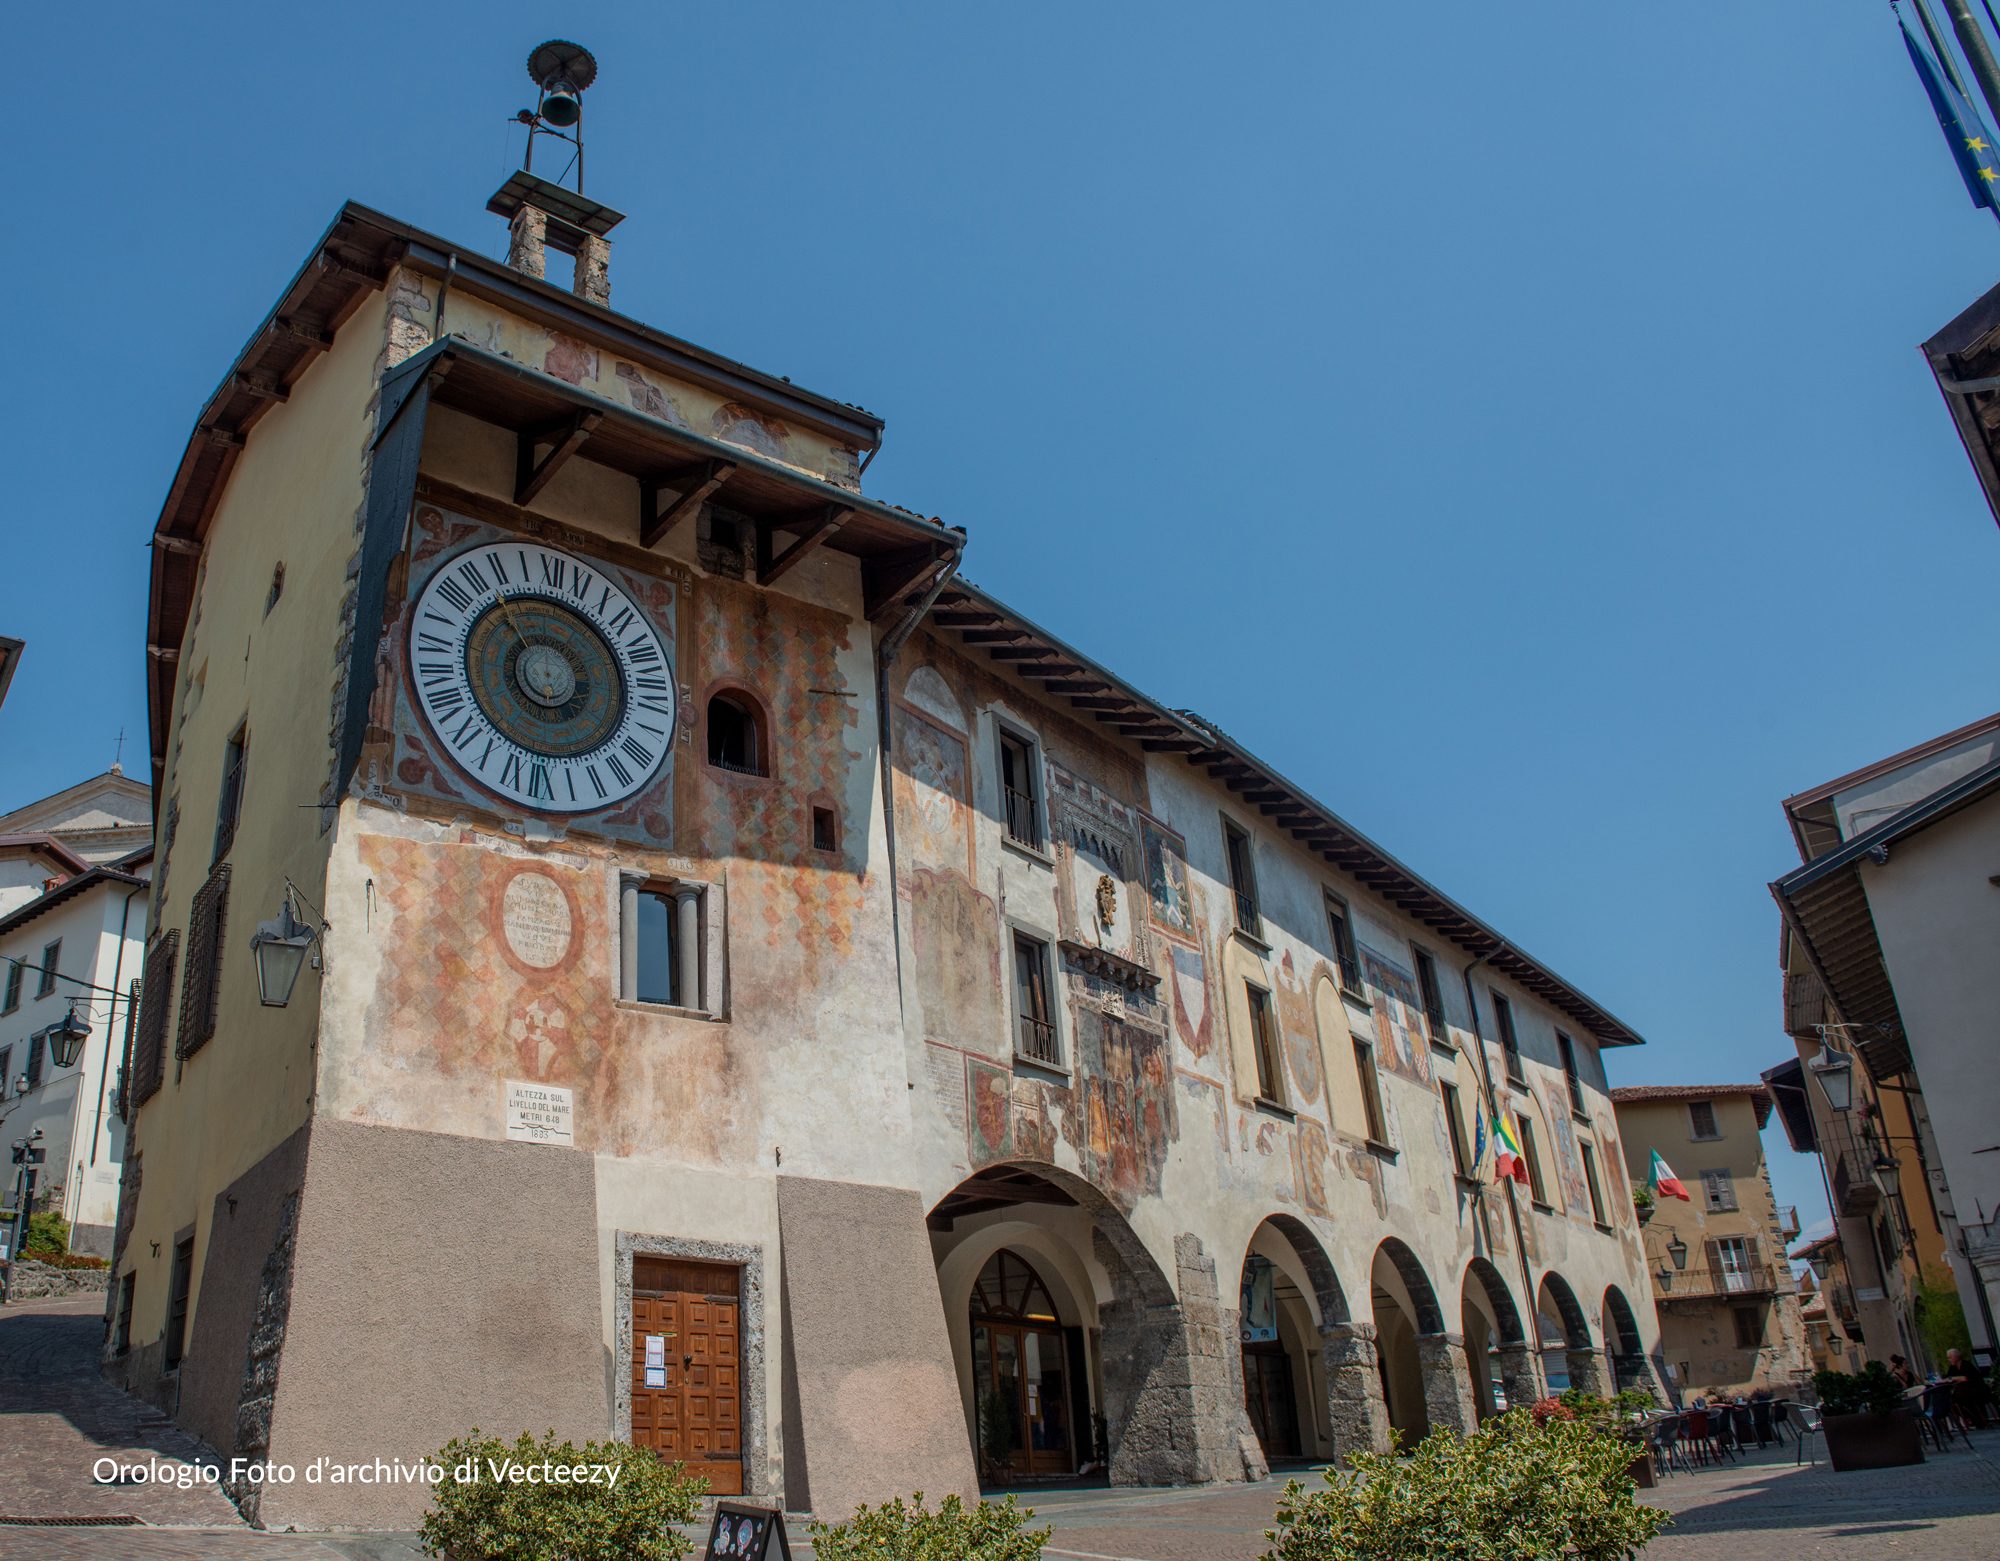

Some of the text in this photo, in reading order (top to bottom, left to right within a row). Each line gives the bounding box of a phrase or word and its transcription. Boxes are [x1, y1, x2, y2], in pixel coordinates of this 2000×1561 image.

[515, 1089, 564, 1103] ALTEZZA SUL
[509, 1099, 570, 1114] LIVELLO DEL MARE
[520, 1111, 543, 1122] METRI
